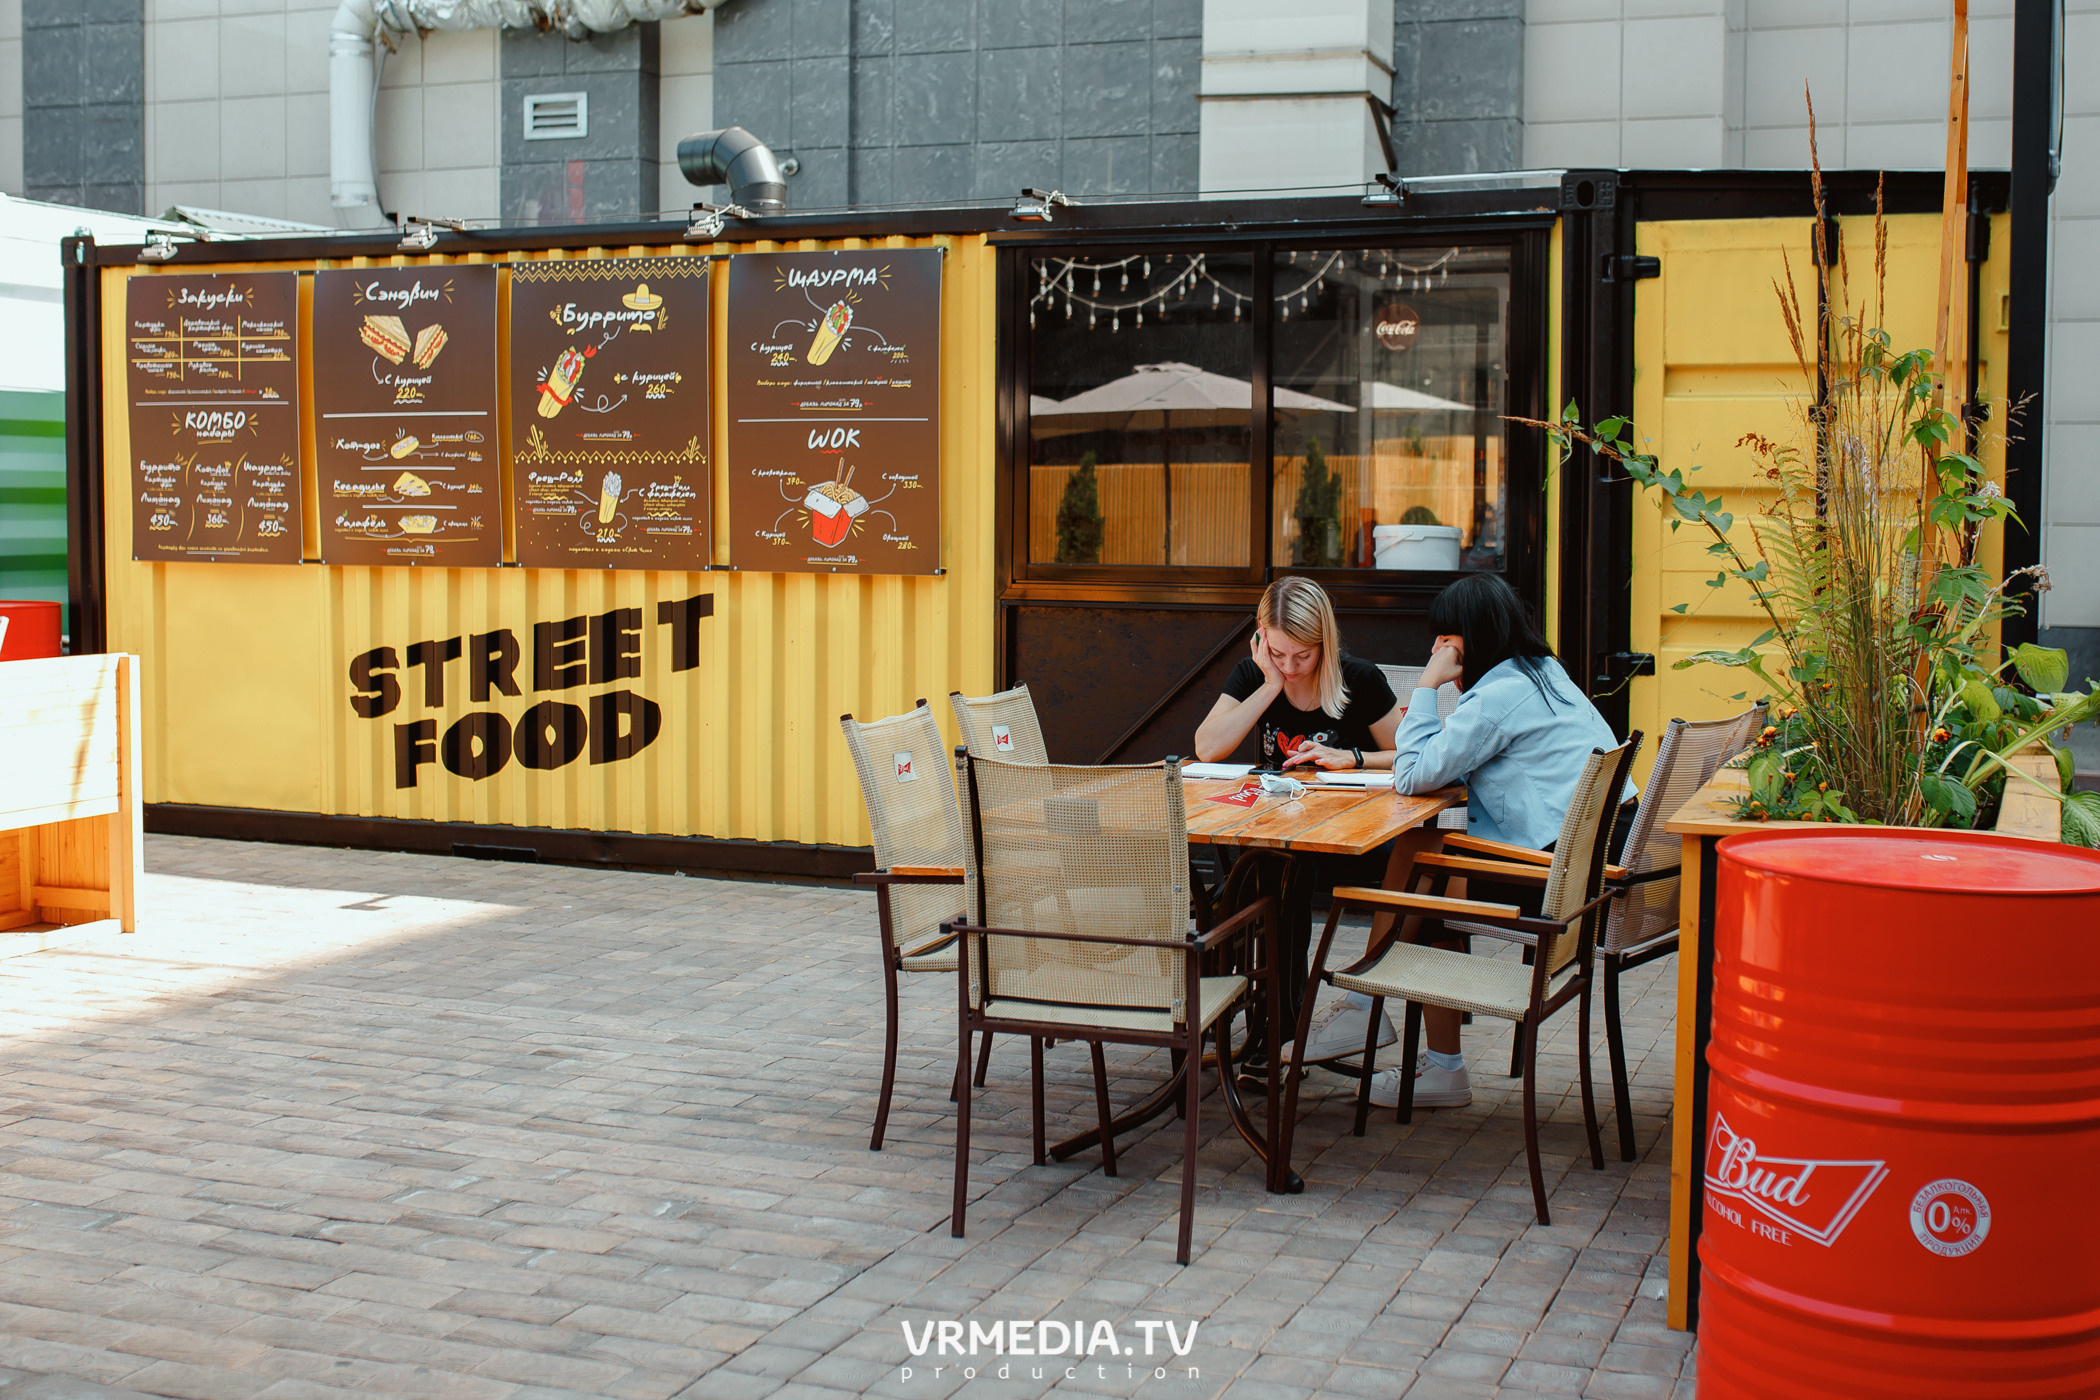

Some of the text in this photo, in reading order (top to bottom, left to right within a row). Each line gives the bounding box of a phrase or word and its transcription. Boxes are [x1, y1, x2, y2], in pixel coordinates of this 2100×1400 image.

[788, 267, 878, 288] ШАУРМА
[178, 287, 244, 310] Закуски
[366, 280, 440, 309] Сэндвич
[563, 303, 656, 332] Буррито
[759, 342, 794, 354] курицей
[394, 374, 432, 388] курицей
[632, 370, 676, 386] курицей
[185, 411, 246, 430] КОМБО
[197, 425, 235, 440] наборы
[807, 427, 861, 449] WOK
[335, 438, 381, 455] Хот-дог
[140, 460, 181, 475] Буррито
[140, 492, 181, 508] Лимонад
[196, 493, 232, 508] Лимонад
[247, 497, 289, 512] Лимонад
[335, 515, 386, 530] Фалафель
[349, 593, 714, 719] STREET
[394, 689, 662, 789] FOOD
[1715, 1125, 1811, 1207] Bud
[1912, 1181, 1989, 1219] БЕЗАЛКОГОЛЬНАЯ
[1751, 1219, 1792, 1247] FREE
[1920, 1233, 1983, 1257] ПРОДУКЦИЯ
